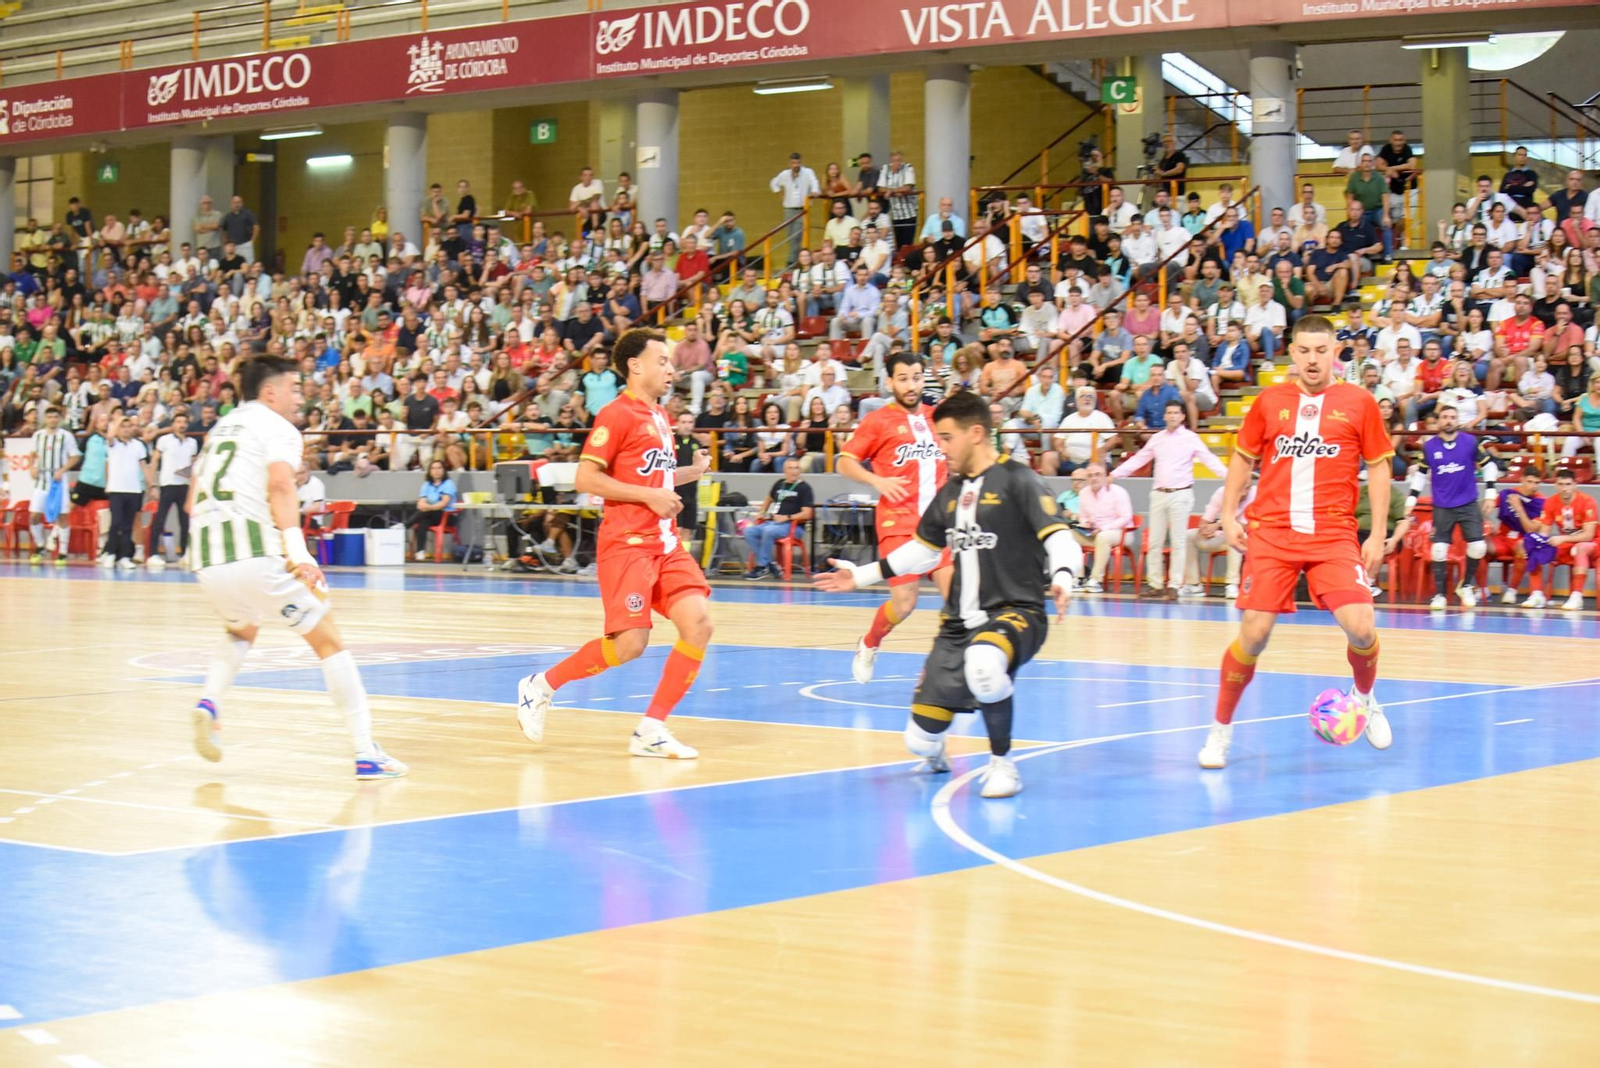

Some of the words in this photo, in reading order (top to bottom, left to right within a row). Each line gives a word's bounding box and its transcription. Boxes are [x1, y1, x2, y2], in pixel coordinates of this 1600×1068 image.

[1303, 3, 1358, 16] Instituto
[1360, 0, 1428, 12] Municipal
[643, 0, 811, 49] IMDECO
[900, 2, 1014, 45] VISTA
[1026, 0, 1196, 35] ALEGRE
[445, 36, 519, 60] AYUNTAMIENTO
[597, 61, 639, 74] Instituto
[640, 55, 691, 70] Municipal
[693, 53, 707, 65] de
[709, 49, 758, 65] Deportes
[759, 44, 808, 59] Córdoba
[184, 53, 311, 101] IMDECO
[445, 63, 459, 80] DE
[459, 58, 508, 79] CÓRDOBA
[1110, 80, 1127, 100] C
[12, 95, 73, 117] Diputación
[148, 110, 180, 123] Instituto
[181, 106, 220, 119] Municipal
[221, 104, 233, 114] de
[233, 100, 272, 115] Deportes
[272, 95, 309, 109] Córdoba
[12, 119, 27, 133] de
[28, 113, 73, 131] Córdoba
[537, 122, 550, 140] B
[102, 164, 114, 180] A
[894, 439, 944, 467] Jimbe
[1271, 430, 1342, 464] Jimbee
